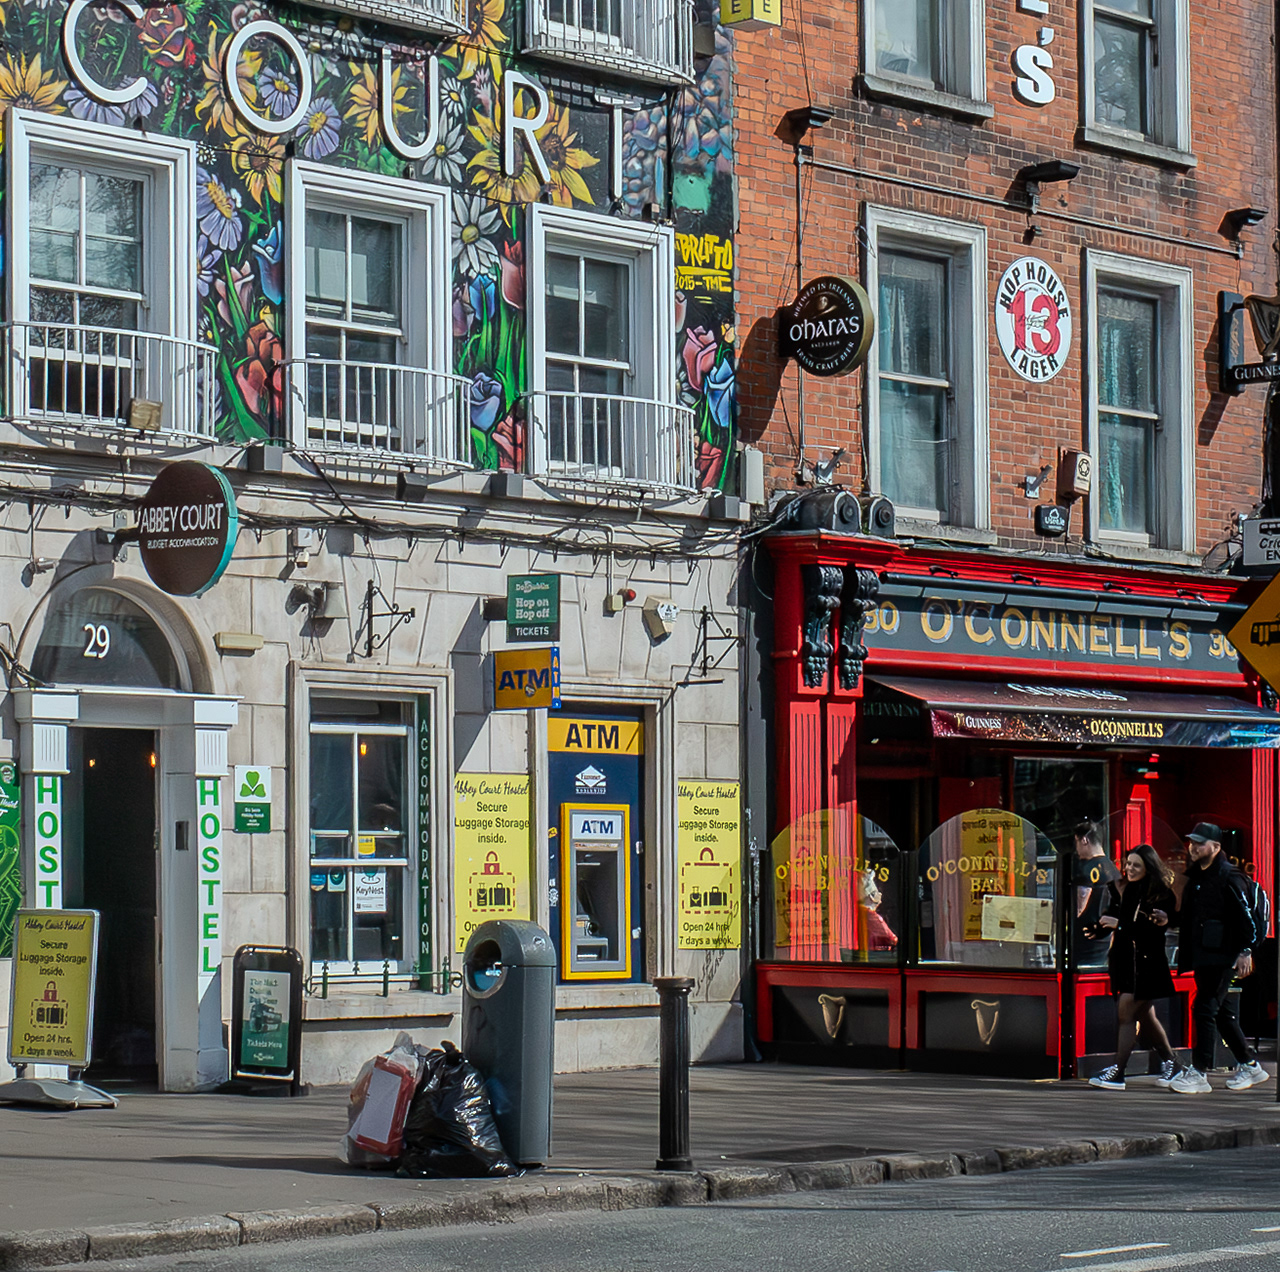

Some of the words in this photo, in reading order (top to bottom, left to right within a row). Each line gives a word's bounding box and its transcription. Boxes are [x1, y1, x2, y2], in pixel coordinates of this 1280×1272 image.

[999, 266, 1022, 309] HOP
[1025, 262, 1069, 320] HOUSE
[1007, 289, 1061, 356] 13
[1010, 345, 1059, 379] LAGER
[140, 506, 179, 534] ABBEY
[180, 503, 224, 531] COURT
[147, 539, 168, 549] BUDGET
[515, 598, 535, 609] Hop
[536, 598, 549, 607] on
[515, 609, 535, 620] Hop
[536, 608, 550, 618] off
[515, 626, 549, 636] TICKETS
[863, 600, 900, 634] 30
[920, 595, 1193, 663] O'CONNELL'S
[83, 623, 110, 659] 29
[498, 667, 550, 691] ATM
[966, 716, 1002, 729] GUINNESS
[1090, 721, 1164, 739] O'CONNELL'S
[565, 723, 619, 749] ATM
[455, 781, 477, 797] Abbey
[478, 781, 501, 795] Court
[503, 781, 529, 795] Hostel
[695, 786, 714, 798] Court
[716, 786, 737, 799] Hostel
[476, 802, 508, 812] Secure
[693, 806, 719, 816] Secure
[455, 817, 493, 830] Luggage
[495, 817, 529, 830] Storage
[581, 820, 614, 834] ATM
[678, 821, 707, 831] uggage
[709, 820, 738, 831] Storage
[37, 776, 59, 908] HOST
[420, 719, 430, 954] ACCOMMODATION
[477, 833, 507, 843] inside.
[694, 833, 719, 842] inside.
[200, 779, 220, 973] HOSTEL
[356, 886, 384, 896] KeyNest
[970, 878, 1005, 893] BAR
[682, 922, 705, 933] Open
[705, 922, 714, 932] 24
[40, 940, 68, 950] Secure
[459, 938, 465, 948] 7
[679, 936, 684, 945] 7
[685, 936, 704, 947] days
[20, 953, 54, 965] Luggage
[56, 953, 87, 964] Storage
[39, 966, 65, 976] inside.
[24, 1033, 45, 1044] Open
[46, 1033, 56, 1043] 24
[20, 1046, 25, 1055] 7
[26, 1046, 46, 1057] days
